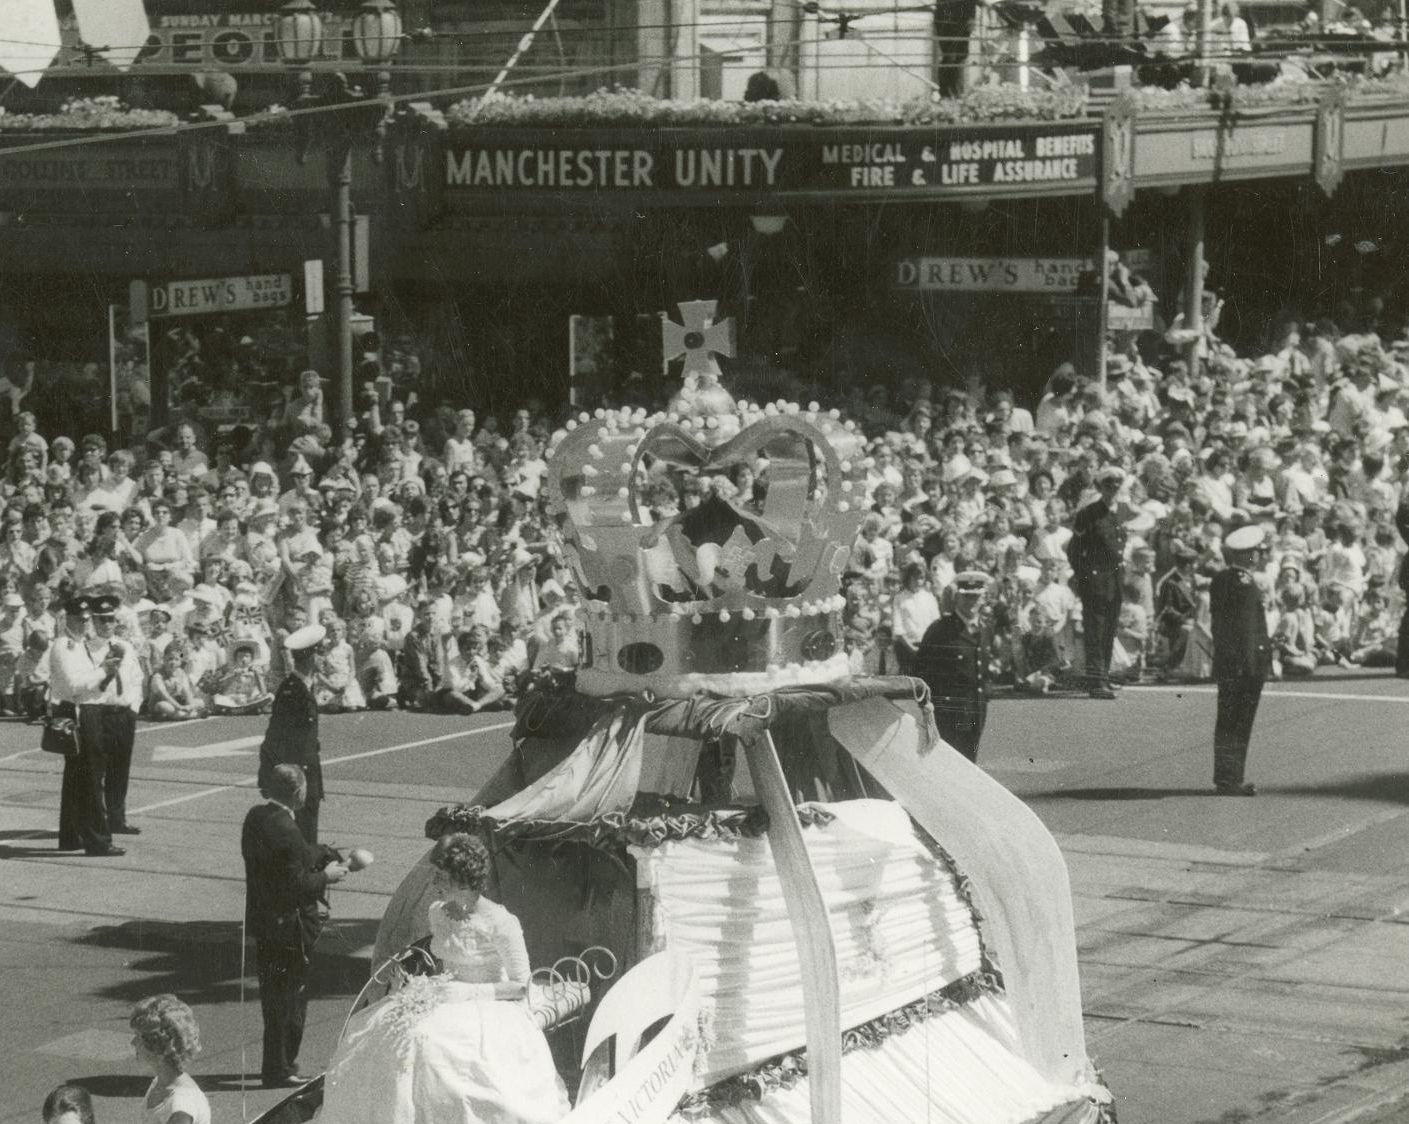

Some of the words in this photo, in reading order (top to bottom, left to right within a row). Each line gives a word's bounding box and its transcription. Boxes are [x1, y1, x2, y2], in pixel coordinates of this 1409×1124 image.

[161, 15, 221, 28] SUNDAY
[823, 143, 906, 163] MEDICAL
[921, 147, 936, 162] &
[950, 140, 1025, 161] HOSPITAL
[1036, 134, 1094, 158] BENEFITS
[446, 149, 654, 187] MANCHESTER
[675, 148, 783, 186] UNITY
[851, 166, 895, 187] FIRE
[912, 168, 927, 186] &
[941, 163, 980, 184] LIFE
[993, 158, 1078, 182] ASSURANCE
[897, 261, 1018, 285] DREW'S
[153, 281, 236, 311] DREW'S
